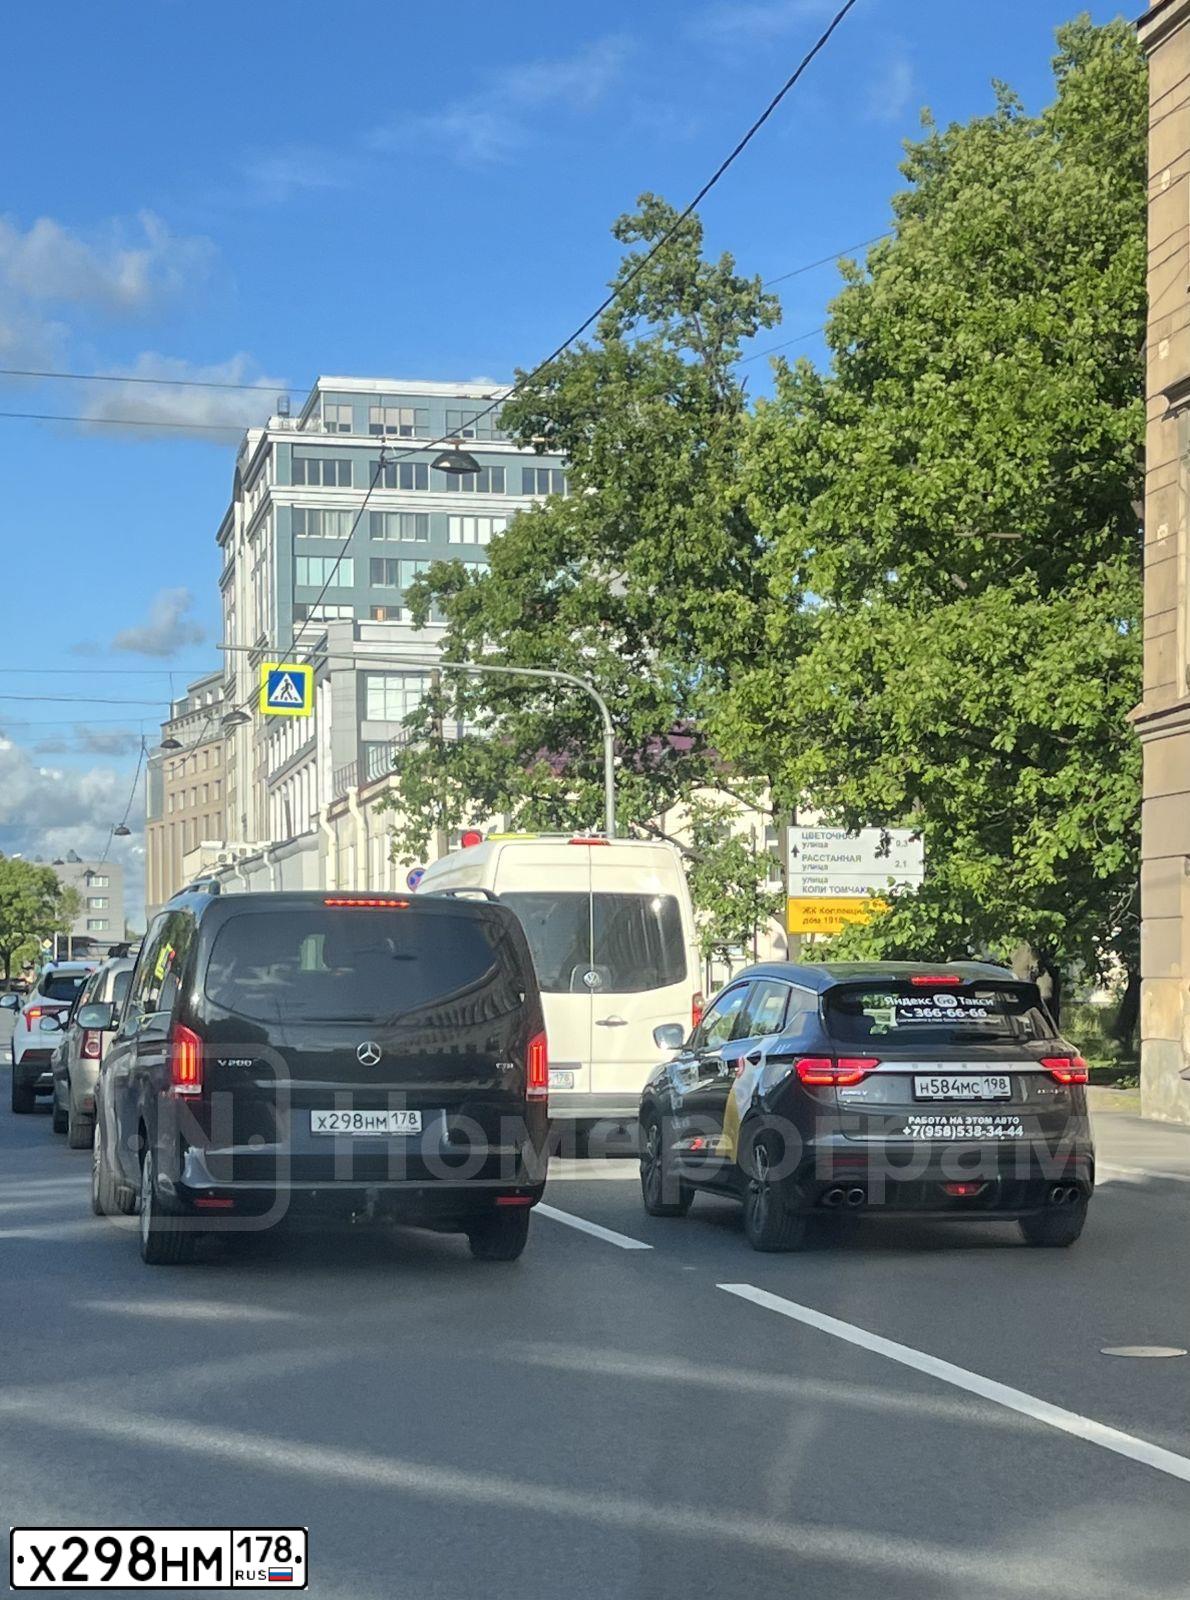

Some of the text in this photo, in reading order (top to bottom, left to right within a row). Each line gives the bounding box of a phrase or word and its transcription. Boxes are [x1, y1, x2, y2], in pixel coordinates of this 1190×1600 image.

[802, 877, 829, 885] улица
[884, 996, 932, 1006] Яндекс
[957, 996, 994, 1006] Такси
[913, 1008, 987, 1018] 366-66-66
[920, 1078, 1006, 1094] Н584МС 198
[317, 1112, 418, 1130] Х298НМ 178
